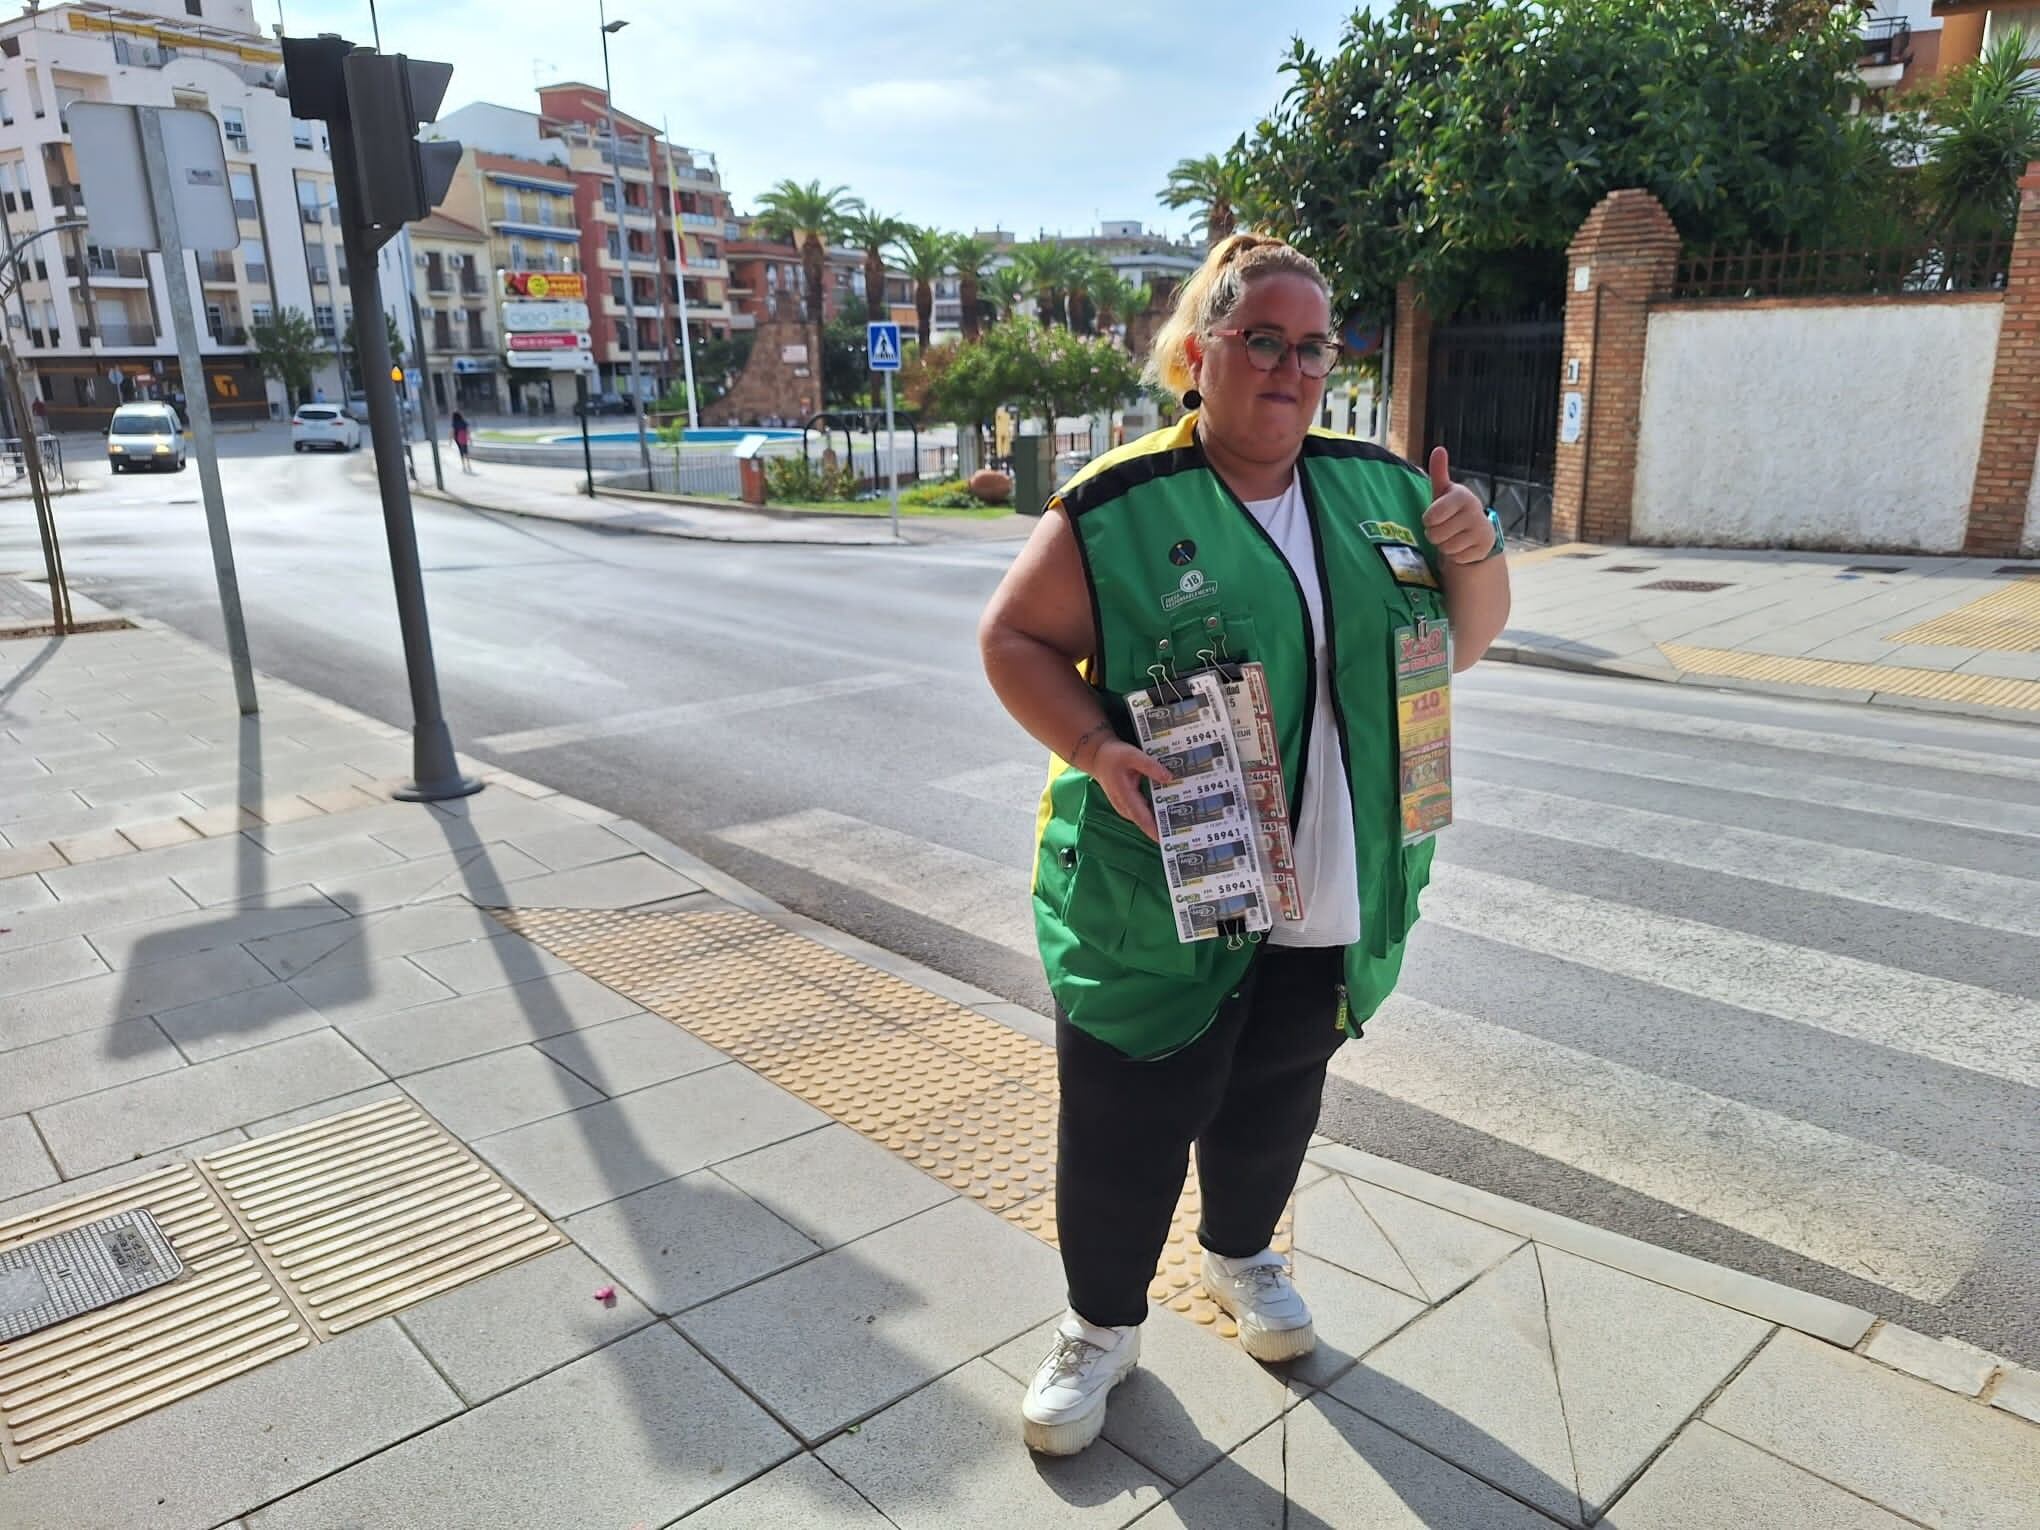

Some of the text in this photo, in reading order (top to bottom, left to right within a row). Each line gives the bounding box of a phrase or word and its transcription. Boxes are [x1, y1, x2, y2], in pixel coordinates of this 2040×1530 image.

[1186, 729, 1218, 745] 58941
[1197, 779, 1230, 794] 58941
[1207, 828, 1240, 842] 58941
[1218, 879, 1252, 894] 58941
